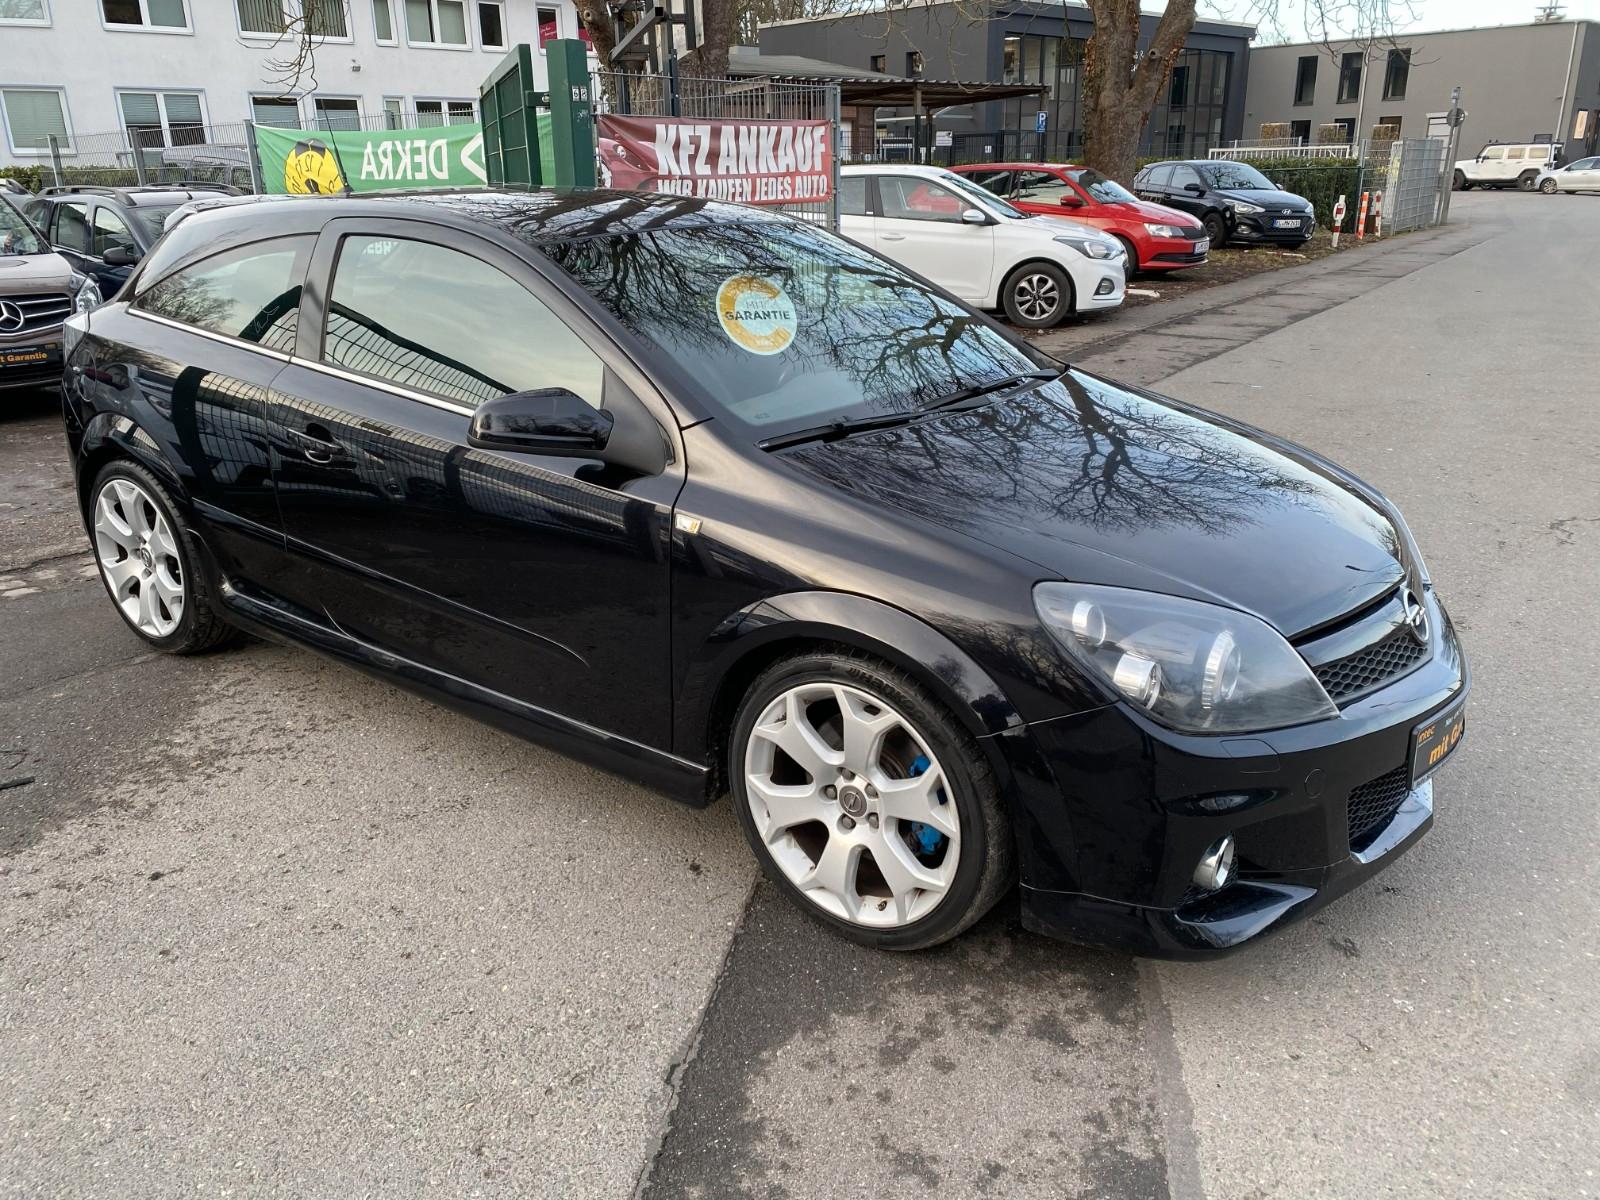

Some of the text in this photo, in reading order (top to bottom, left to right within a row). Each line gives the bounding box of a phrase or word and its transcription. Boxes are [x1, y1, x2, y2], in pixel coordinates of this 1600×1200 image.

[1039, 113, 1046, 125] P
[655, 124, 826, 175] KFZ ANKAUF
[696, 178, 752, 202] KAUFEN
[754, 176, 791, 201] JEDES
[795, 174, 828, 198] AUTO
[725, 310, 791, 321] GARANTIE
[7, 352, 48, 361] Garantie
[1429, 735, 1449, 764] mit
